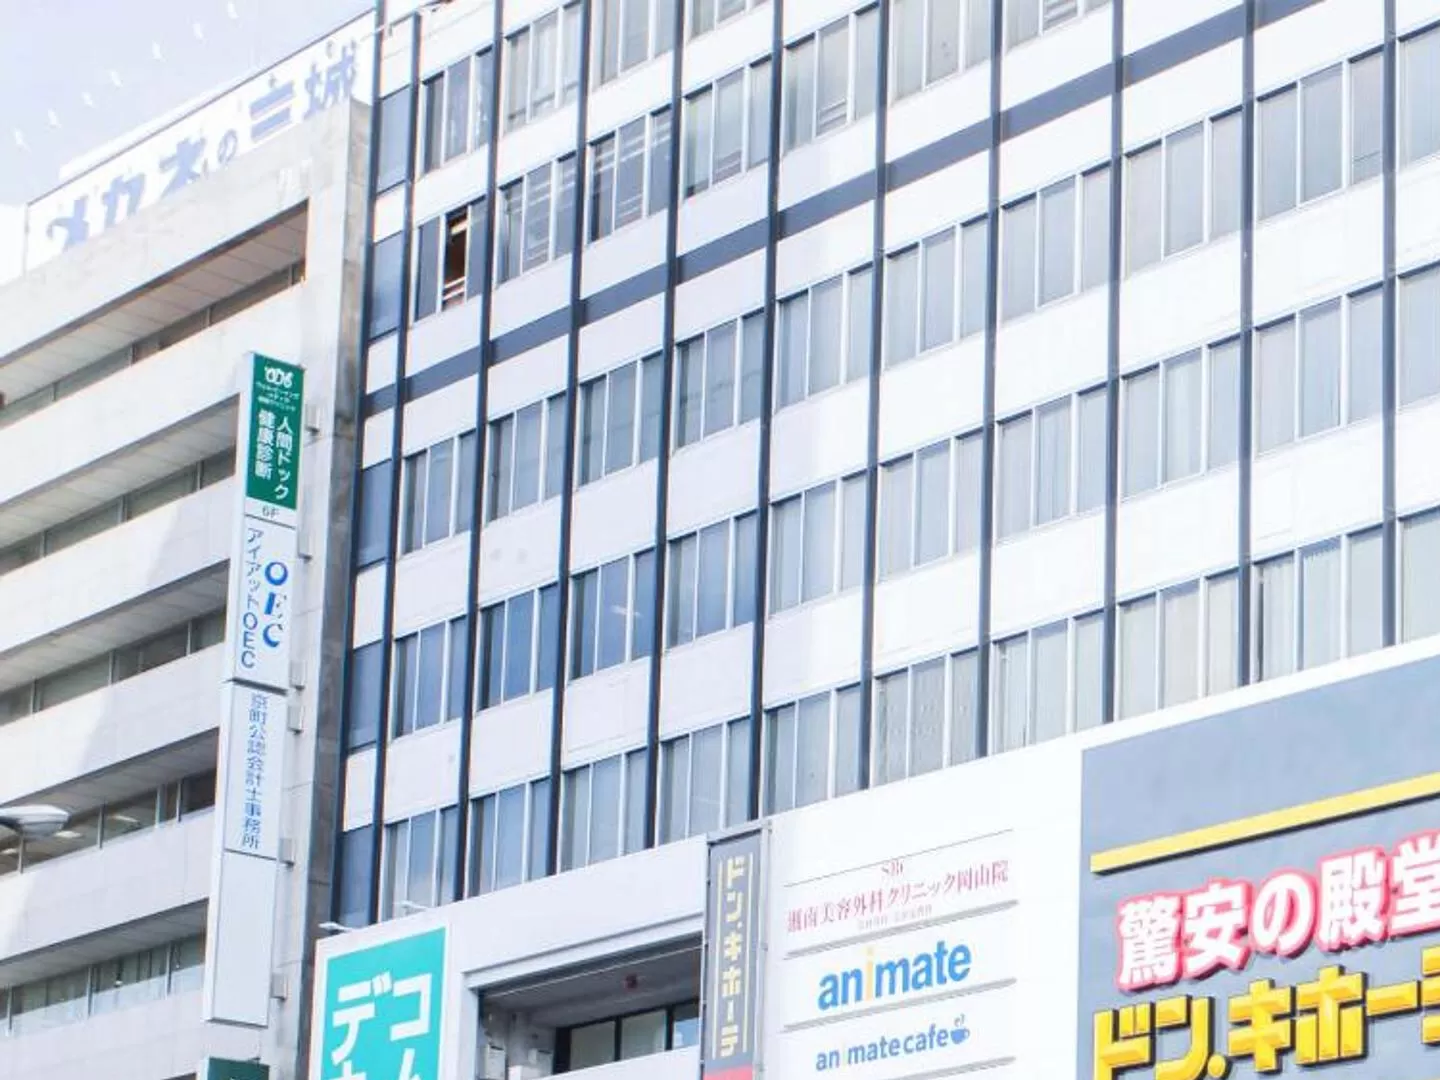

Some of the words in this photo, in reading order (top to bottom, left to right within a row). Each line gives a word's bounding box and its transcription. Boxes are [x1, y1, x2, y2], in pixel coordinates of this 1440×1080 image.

[254, 410, 275, 481] 健康診断
[276, 416, 294, 500] 人間ドック
[818, 940, 972, 1011] animate
[331, 971, 431, 1064] デコ
